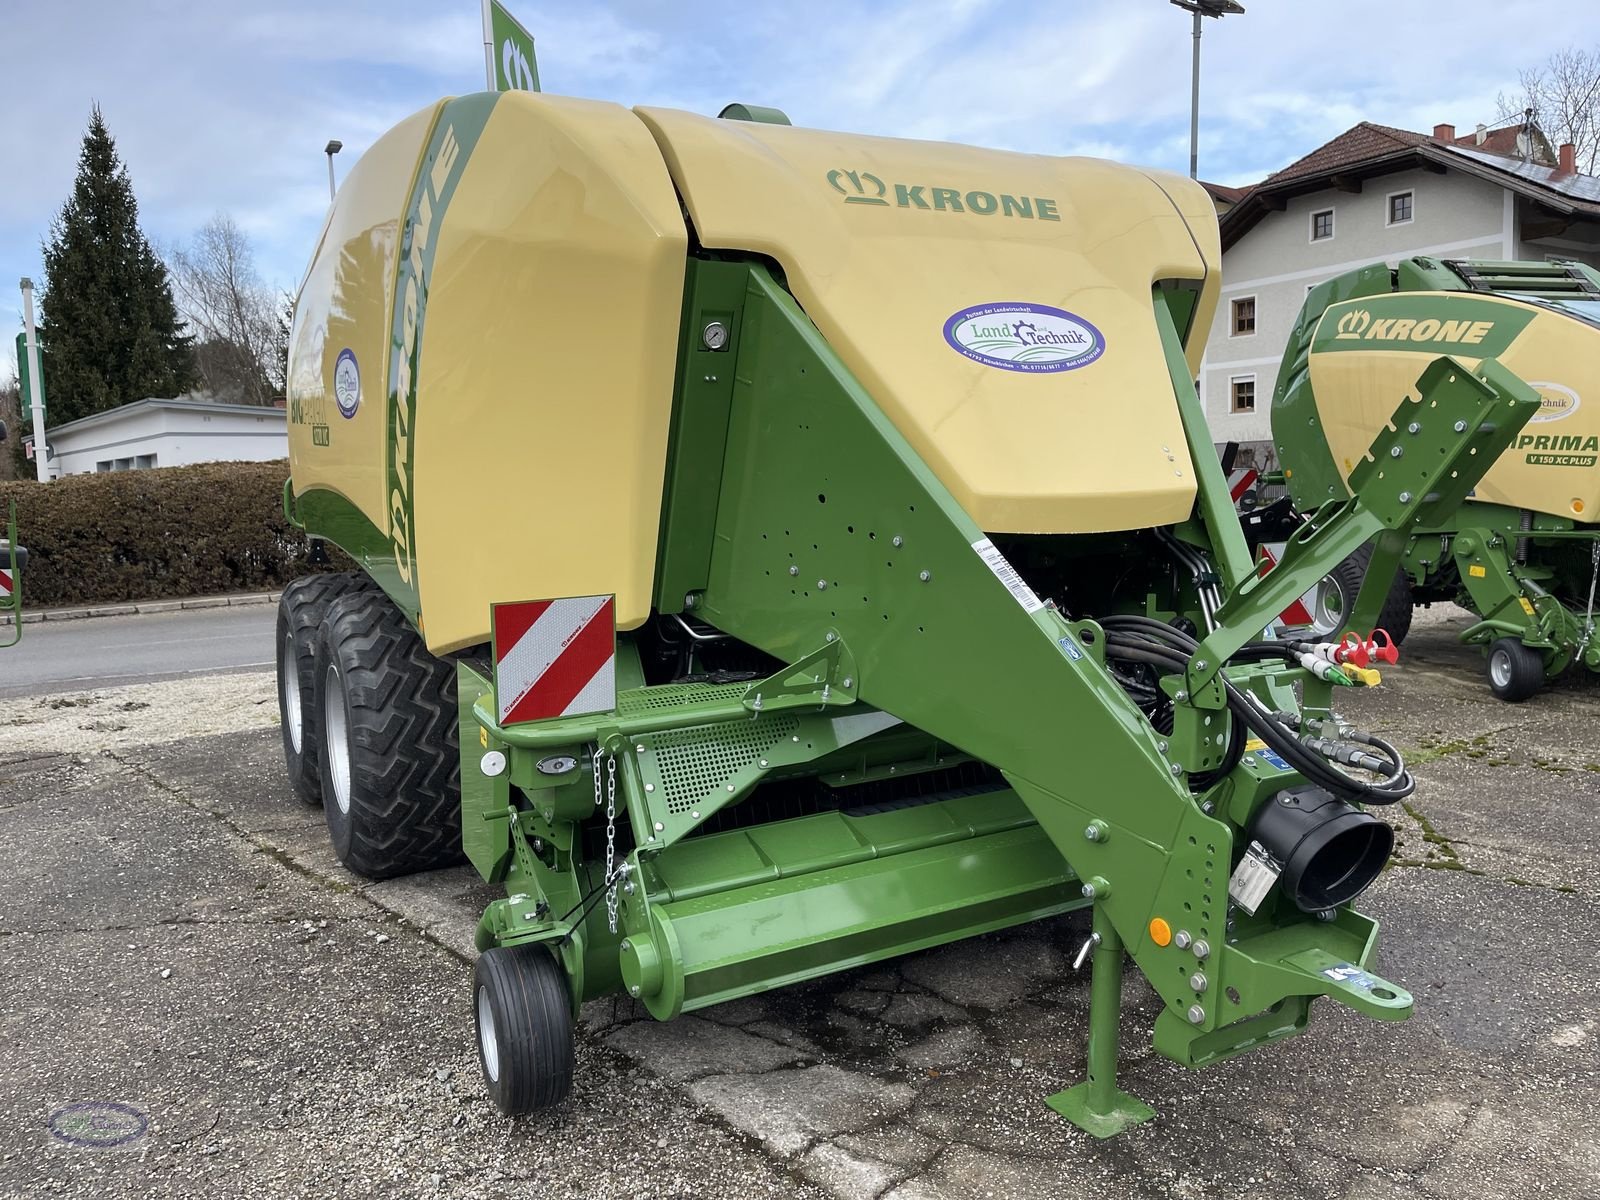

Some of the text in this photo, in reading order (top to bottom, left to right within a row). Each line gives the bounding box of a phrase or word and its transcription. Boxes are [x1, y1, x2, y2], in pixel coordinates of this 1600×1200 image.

[894, 183, 1061, 221] KRONE
[395, 123, 459, 499] KRONE
[970, 323, 1013, 338] Land
[1026, 331, 1087, 345] Technik
[1364, 318, 1495, 344] KRONE
[1542, 398, 1567, 408] chnik
[1530, 455, 1593, 466] V 150 XC PLUS
